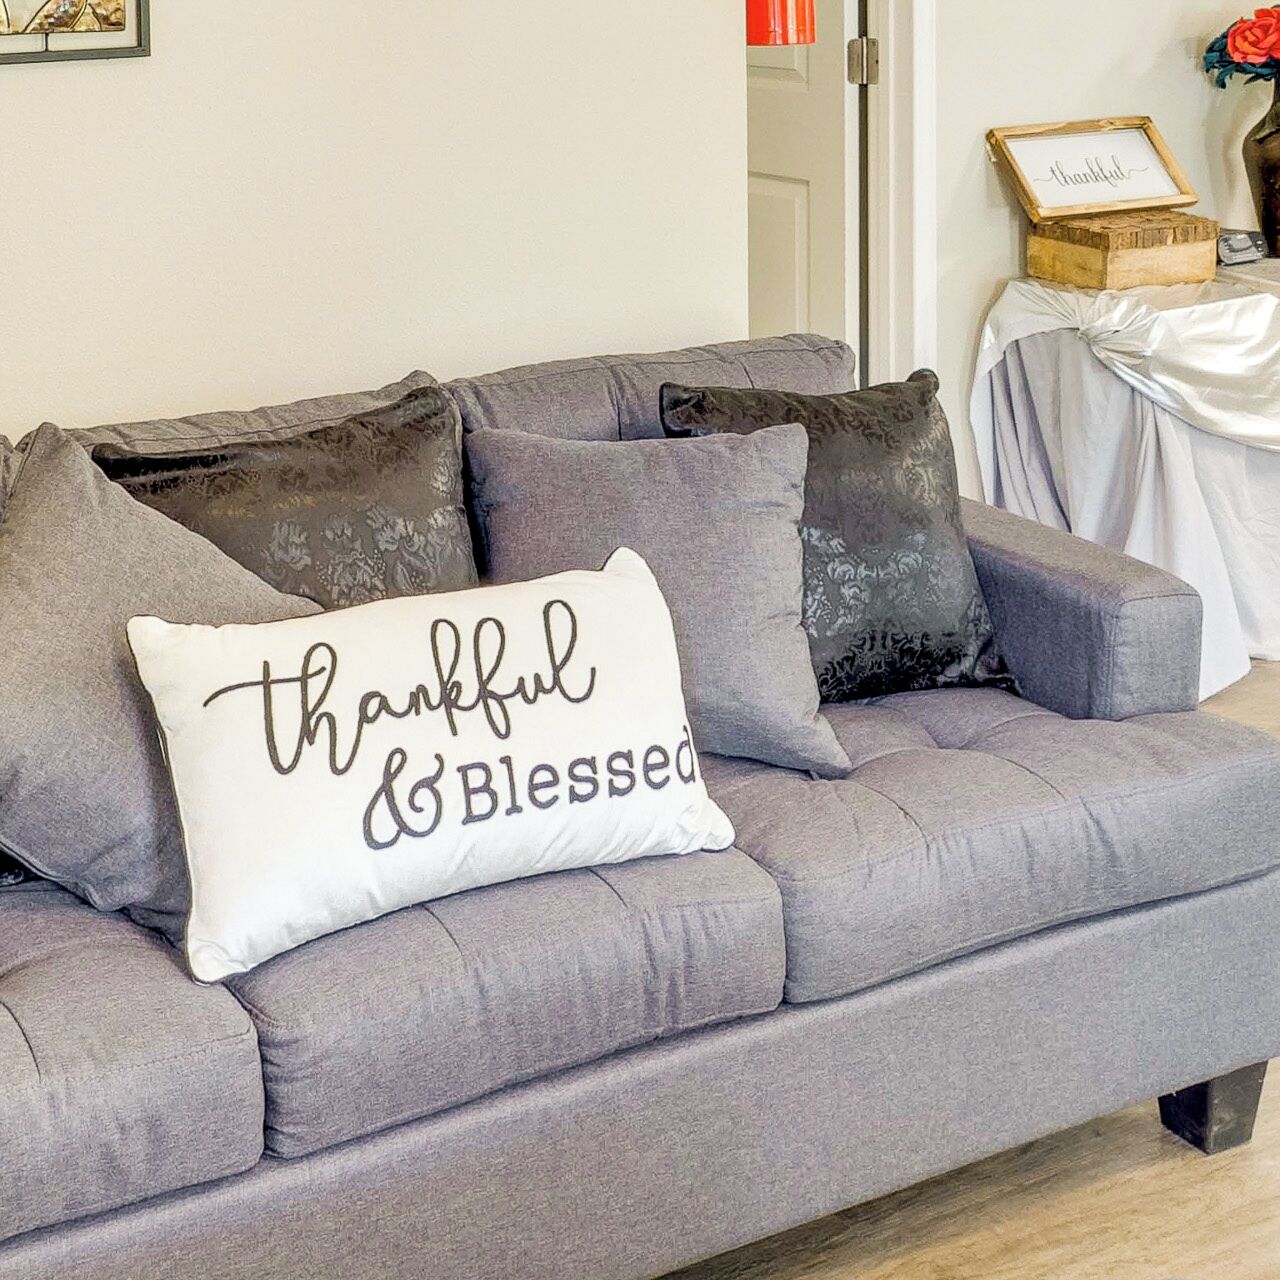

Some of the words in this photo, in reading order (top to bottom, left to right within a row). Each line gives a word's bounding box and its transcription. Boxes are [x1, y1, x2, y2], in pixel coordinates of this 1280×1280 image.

[1033, 154, 1149, 188] thankful
[203, 600, 596, 775] thankful
[363, 747, 445, 850] &
[457, 725, 697, 826] Blessed
